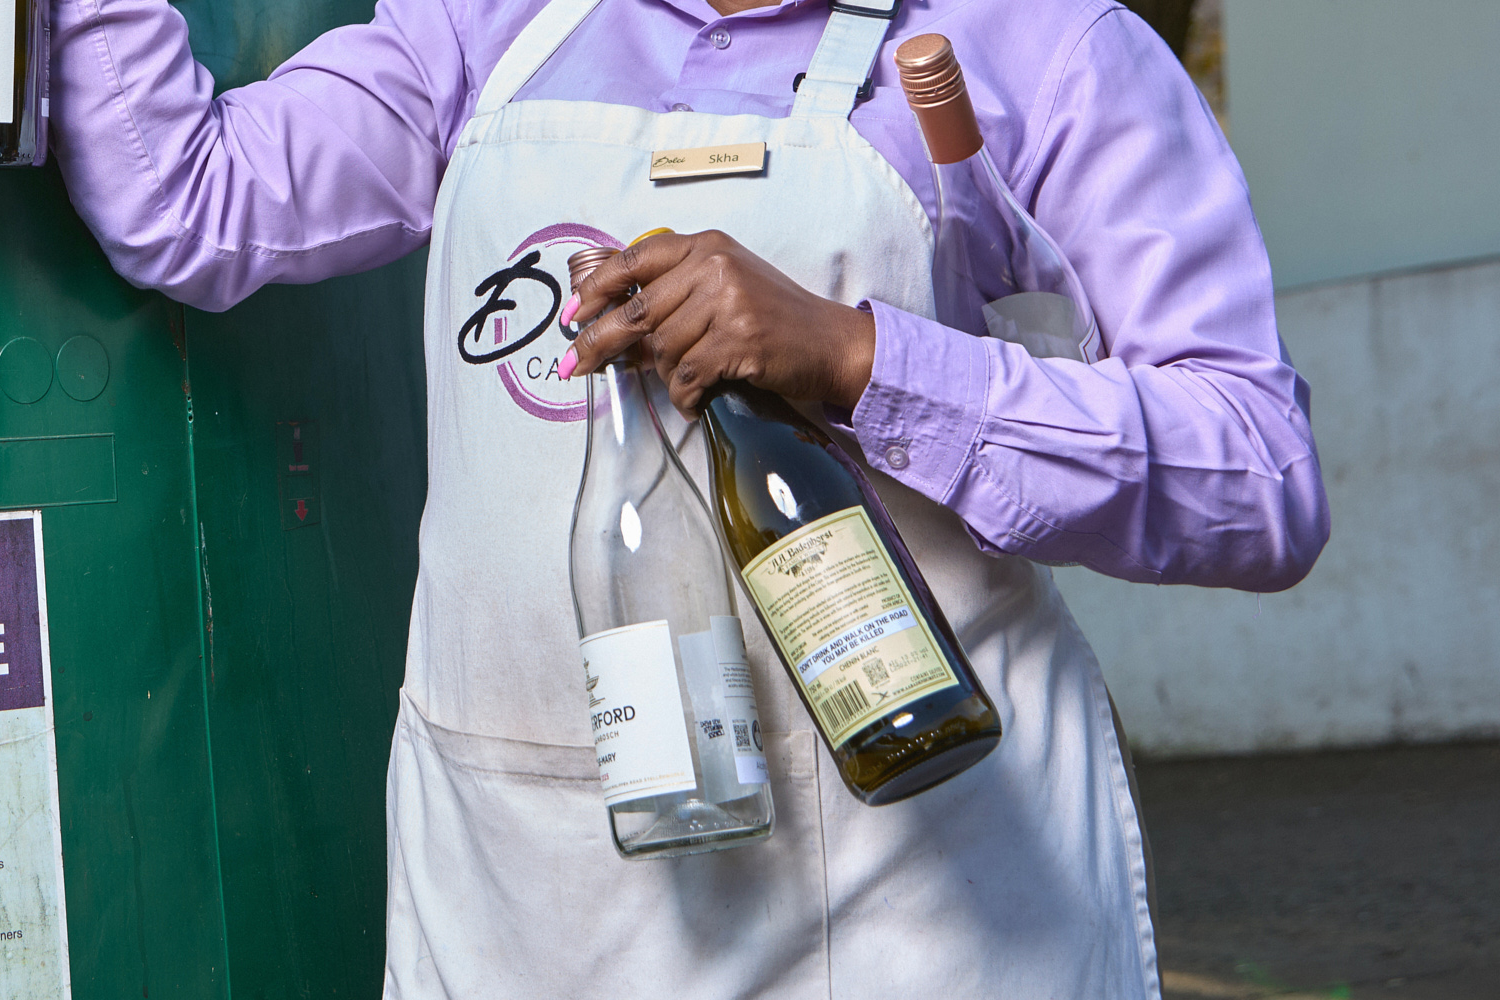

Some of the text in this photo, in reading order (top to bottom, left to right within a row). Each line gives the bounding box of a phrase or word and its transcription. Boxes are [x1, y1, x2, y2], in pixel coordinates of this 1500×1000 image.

[708, 153, 739, 164] Skha
[799, 660, 813, 674] DON'T
[812, 648, 830, 664] DRINK
[829, 639, 844, 653] AND
[843, 628, 864, 643] WALK
[863, 622, 875, 633] ON
[875, 615, 890, 627] THE
[889, 609, 908, 621] ROAD
[821, 627, 885, 666] YOU MAY BE KILLED
[838, 646, 880, 672] CHENIN BLANC
